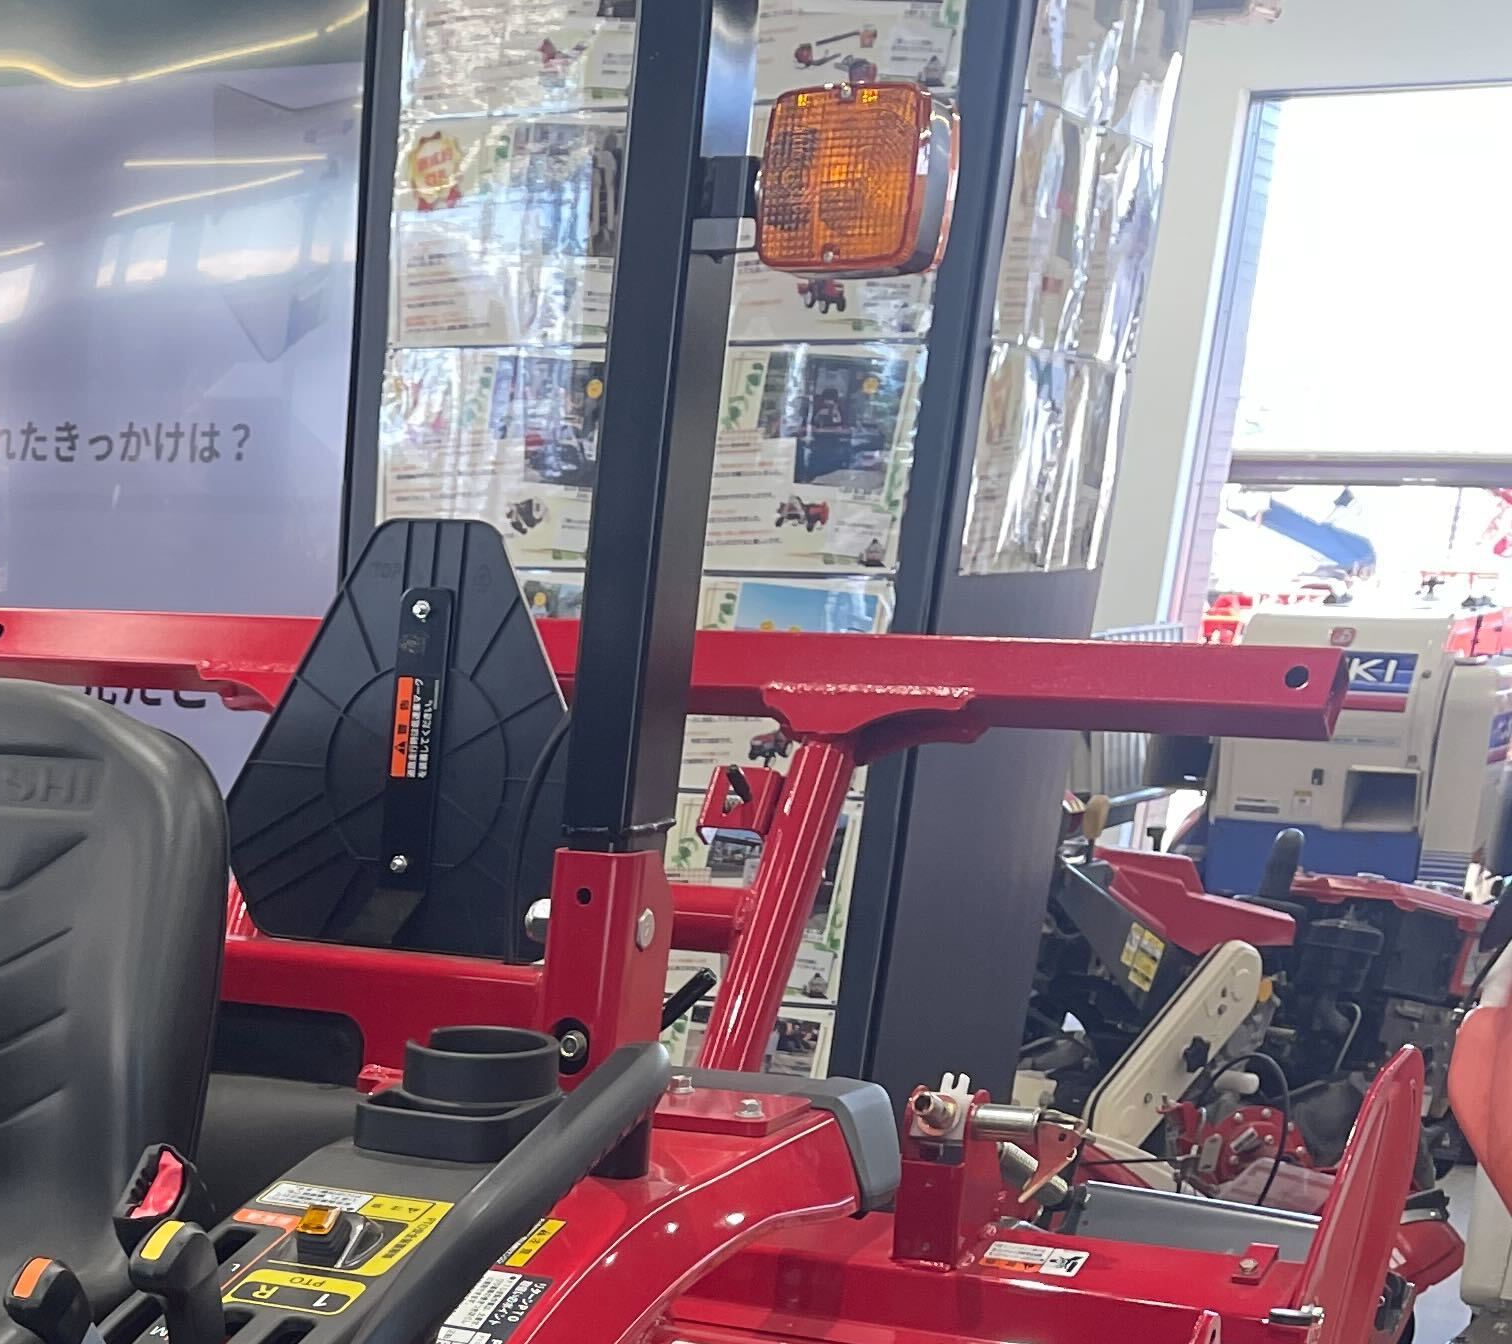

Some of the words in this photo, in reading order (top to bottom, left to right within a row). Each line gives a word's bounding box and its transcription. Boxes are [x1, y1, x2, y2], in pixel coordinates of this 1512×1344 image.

[1345, 657, 1398, 683] KI
[289, 1274, 326, 1289] PTO
[250, 1282, 279, 1302] R
